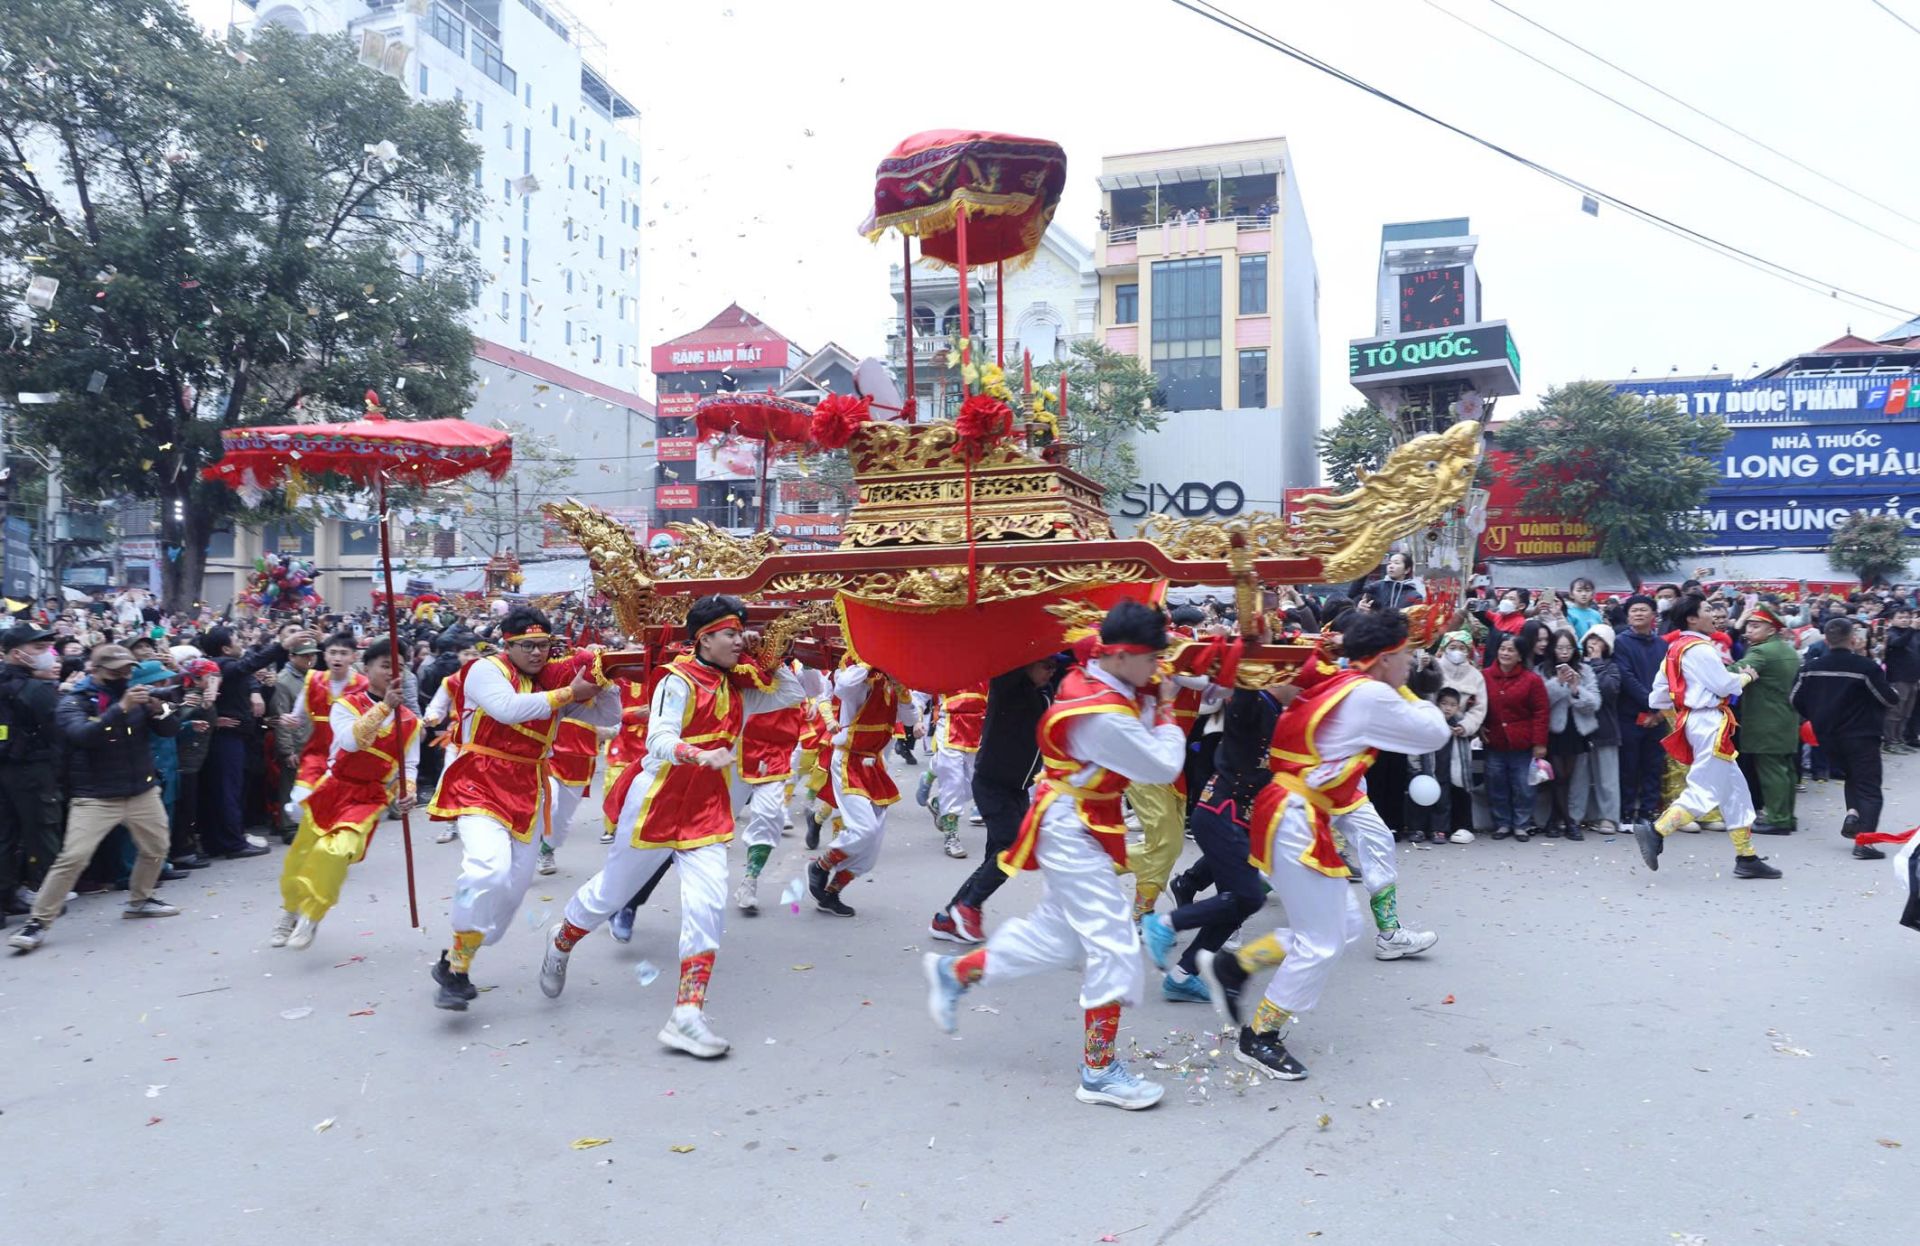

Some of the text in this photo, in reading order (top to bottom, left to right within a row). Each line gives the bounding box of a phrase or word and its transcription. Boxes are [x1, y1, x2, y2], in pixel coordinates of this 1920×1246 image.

[1414, 275, 1425, 283] 11
[1427, 270, 1439, 279] 12
[1444, 271, 1450, 280] 1
[1404, 287, 1415, 296] 10
[1453, 281, 1460, 289] 2
[672, 348, 705, 364] RĂNG
[707, 346, 734, 363] HÀM
[1363, 339, 1398, 368] TỔ
[1401, 331, 1479, 364] QUỐC.
[1693, 391, 1721, 413] TY
[1725, 387, 1787, 415] DƯỢC
[1792, 380, 1858, 411] PHẨM
[1772, 428, 1882, 449] NHÀ THUỐC
[1726, 447, 1920, 478] LONG CHÂU
[1119, 480, 1245, 517] SIXDO
[1735, 500, 1852, 531] CHỦNG
[1519, 520, 1560, 536] VÀNG
[1514, 537, 1563, 554] TƯỜNG
